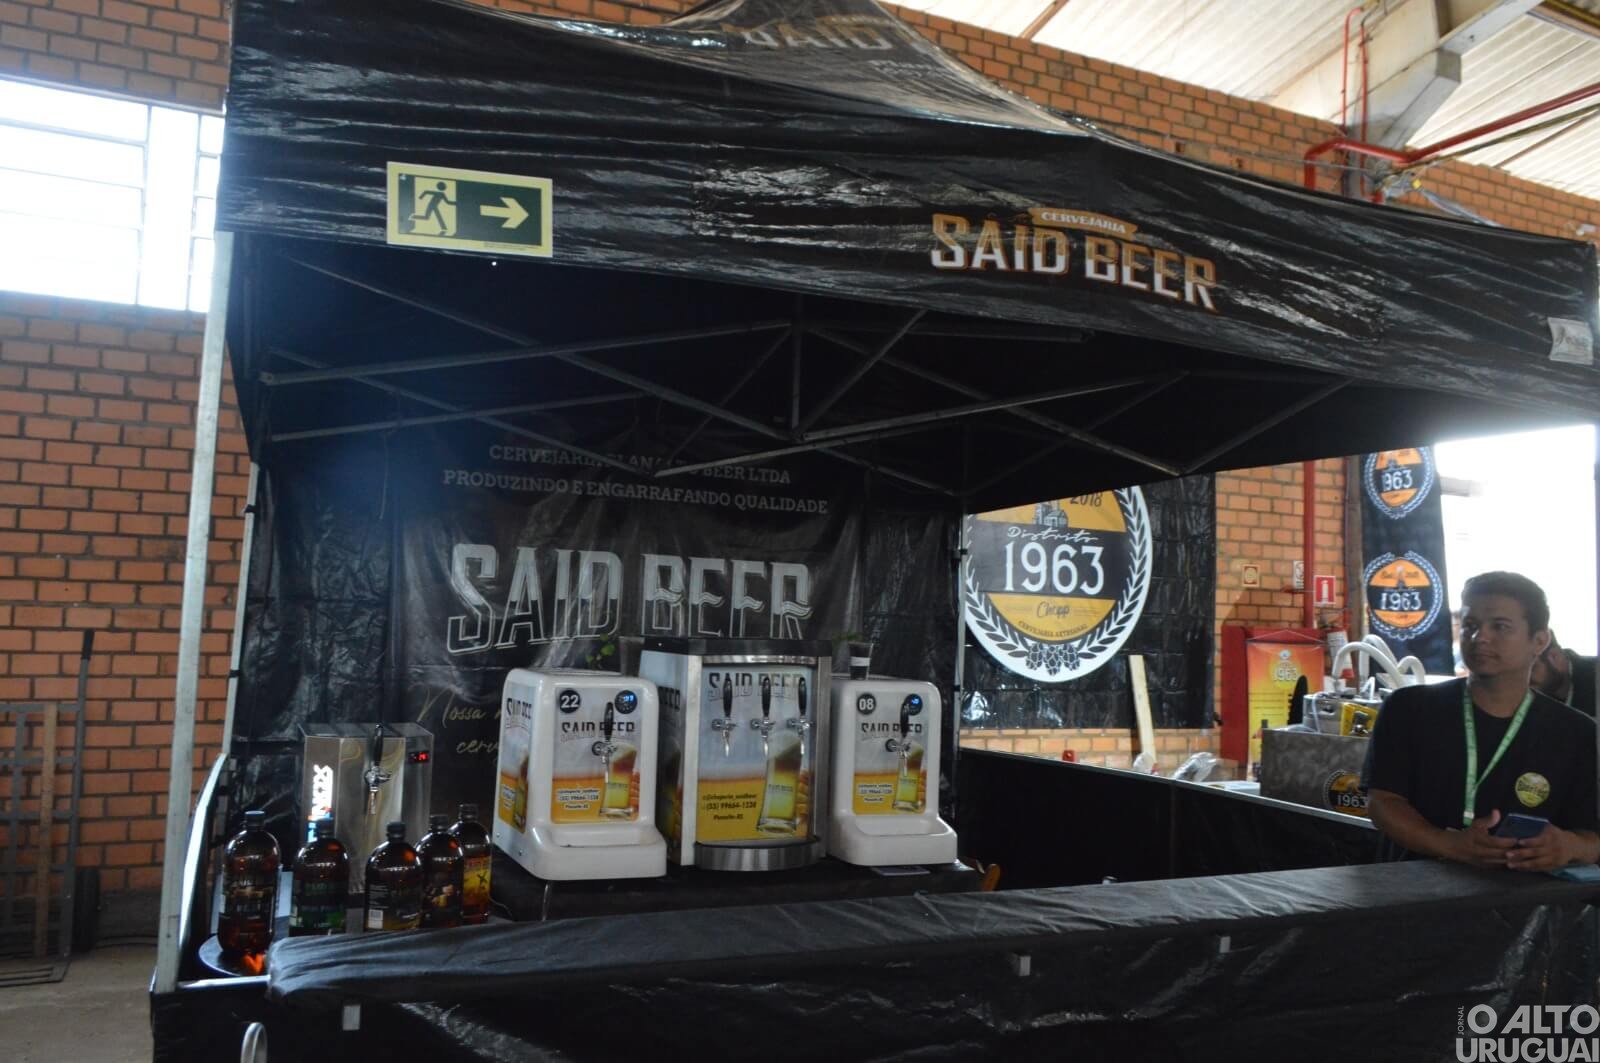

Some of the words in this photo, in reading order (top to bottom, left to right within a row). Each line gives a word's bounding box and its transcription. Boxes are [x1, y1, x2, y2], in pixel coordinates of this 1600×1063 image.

[1039, 210, 1128, 234] CERVEJARIA
[930, 212, 1070, 275] SAID
[1084, 234, 1219, 313] BEER
[748, 467, 791, 485] LTDA
[443, 469, 569, 494] PRODUZINDO
[571, 480, 584, 496] E
[586, 481, 731, 507] ENGARRAFANDO
[734, 493, 829, 514] QUALIDADE
[1007, 525, 1099, 544] Distrito
[1004, 541, 1105, 596] 1963
[446, 542, 625, 655] SAID
[640, 553, 815, 641] BEER
[1380, 591, 1422, 611] 1963
[561, 694, 580, 709] 22
[858, 698, 875, 711] 08
[561, 721, 596, 739] SAID
[1337, 792, 1369, 809] 1963
